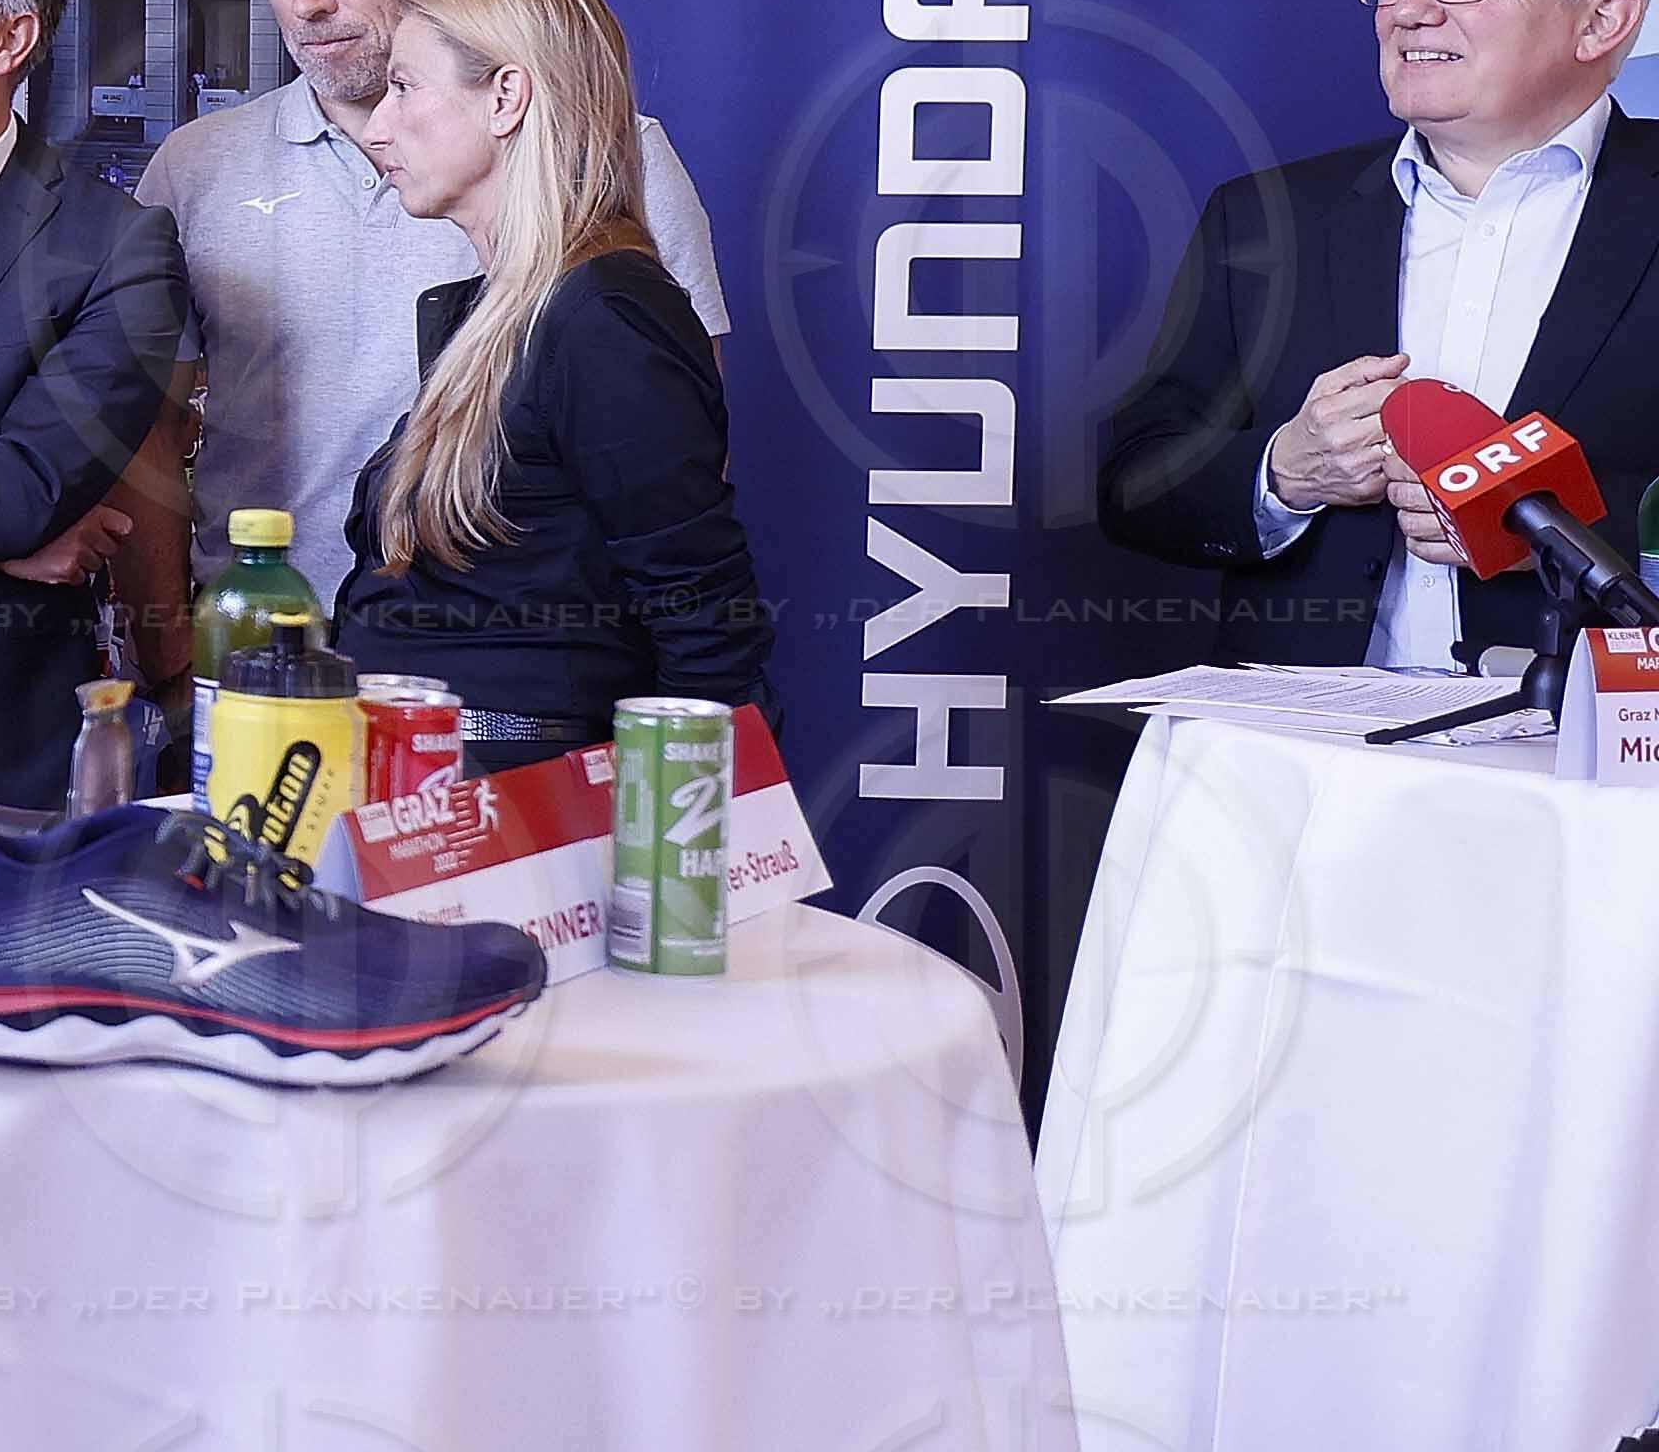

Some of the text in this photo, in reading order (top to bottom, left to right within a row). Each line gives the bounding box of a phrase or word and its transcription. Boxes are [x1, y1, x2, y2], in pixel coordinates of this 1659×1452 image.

[1438, 420, 1548, 492] ORF
[1607, 631, 1643, 640] KLEINE
[1618, 708, 1651, 722] Graz
[389, 786, 456, 834] GRAZ
